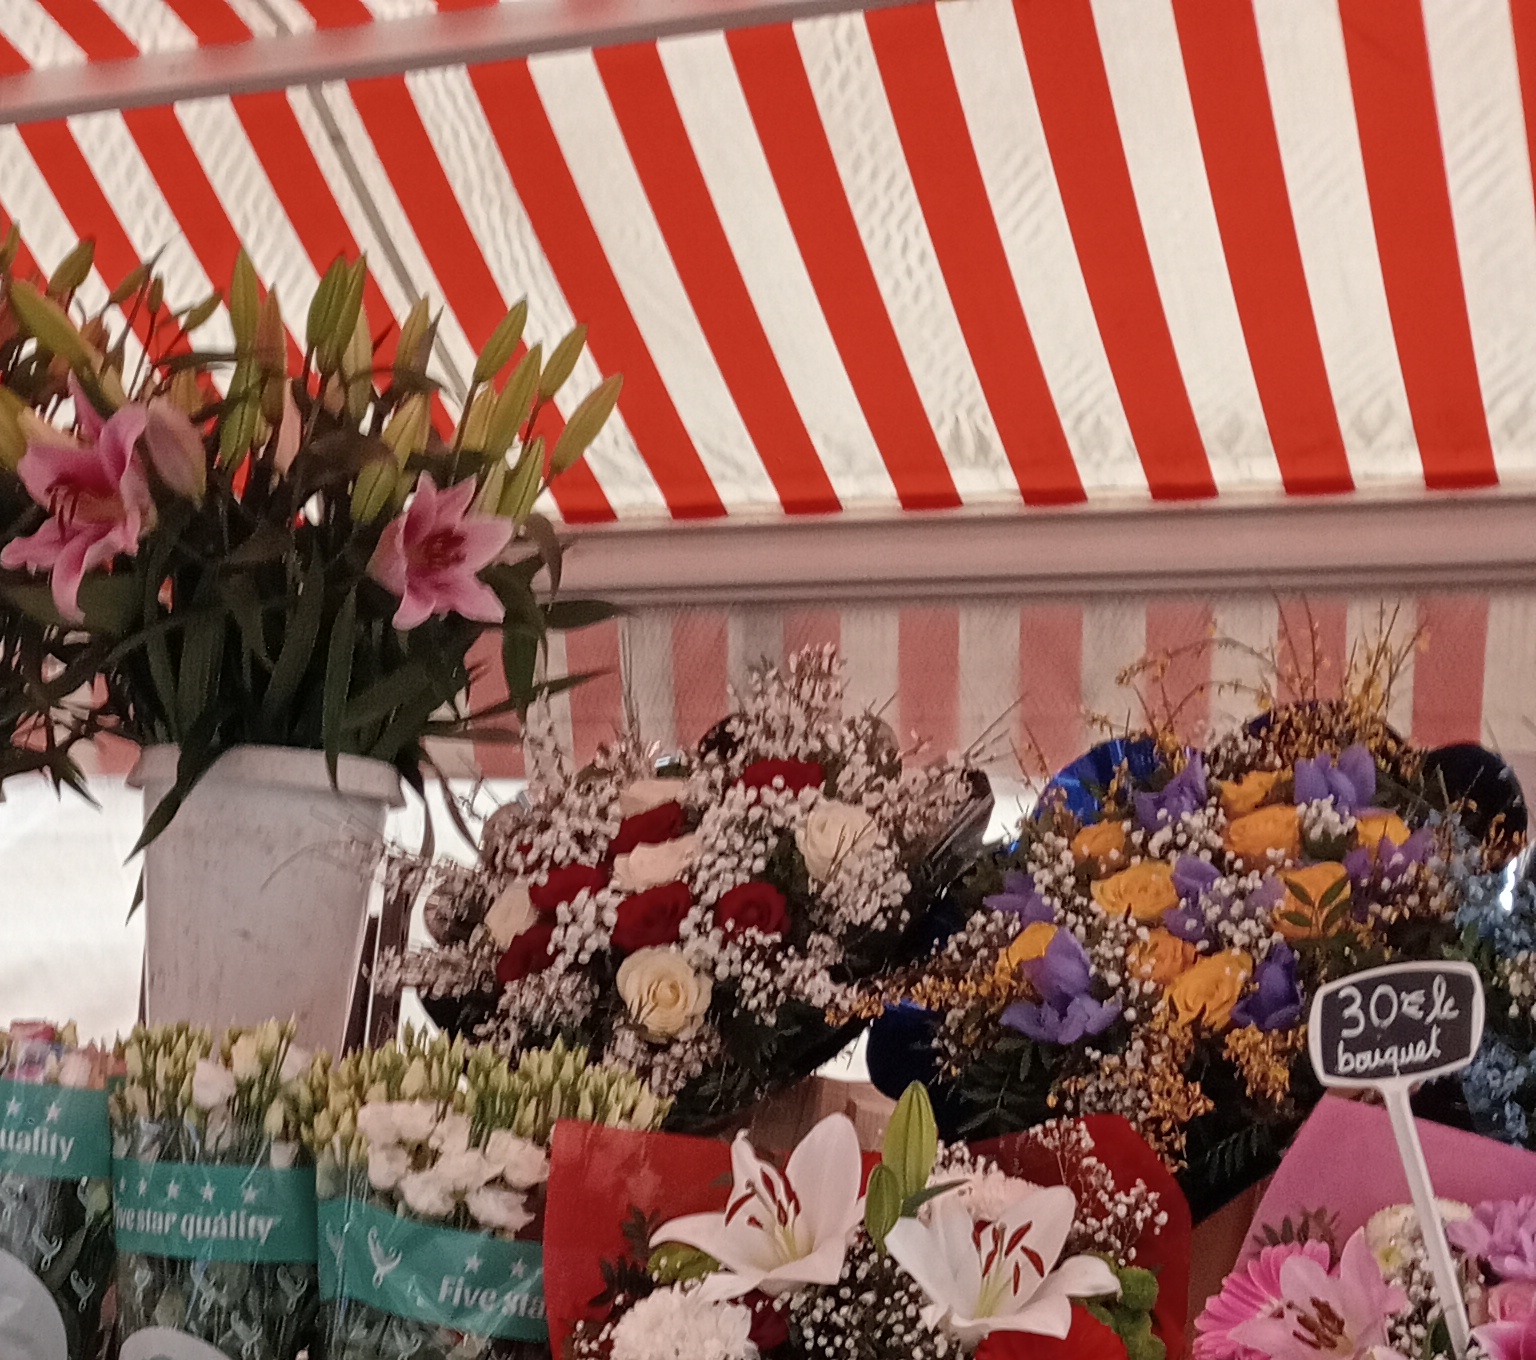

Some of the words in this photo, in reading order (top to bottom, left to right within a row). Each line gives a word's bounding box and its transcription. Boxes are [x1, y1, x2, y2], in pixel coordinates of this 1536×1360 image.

[1337, 1023, 1442, 1078] bouquet
[136, 1207, 178, 1236] star
[180, 1208, 279, 1245] quality
[438, 1275, 499, 1313] Five
[503, 1289, 546, 1319] sta
